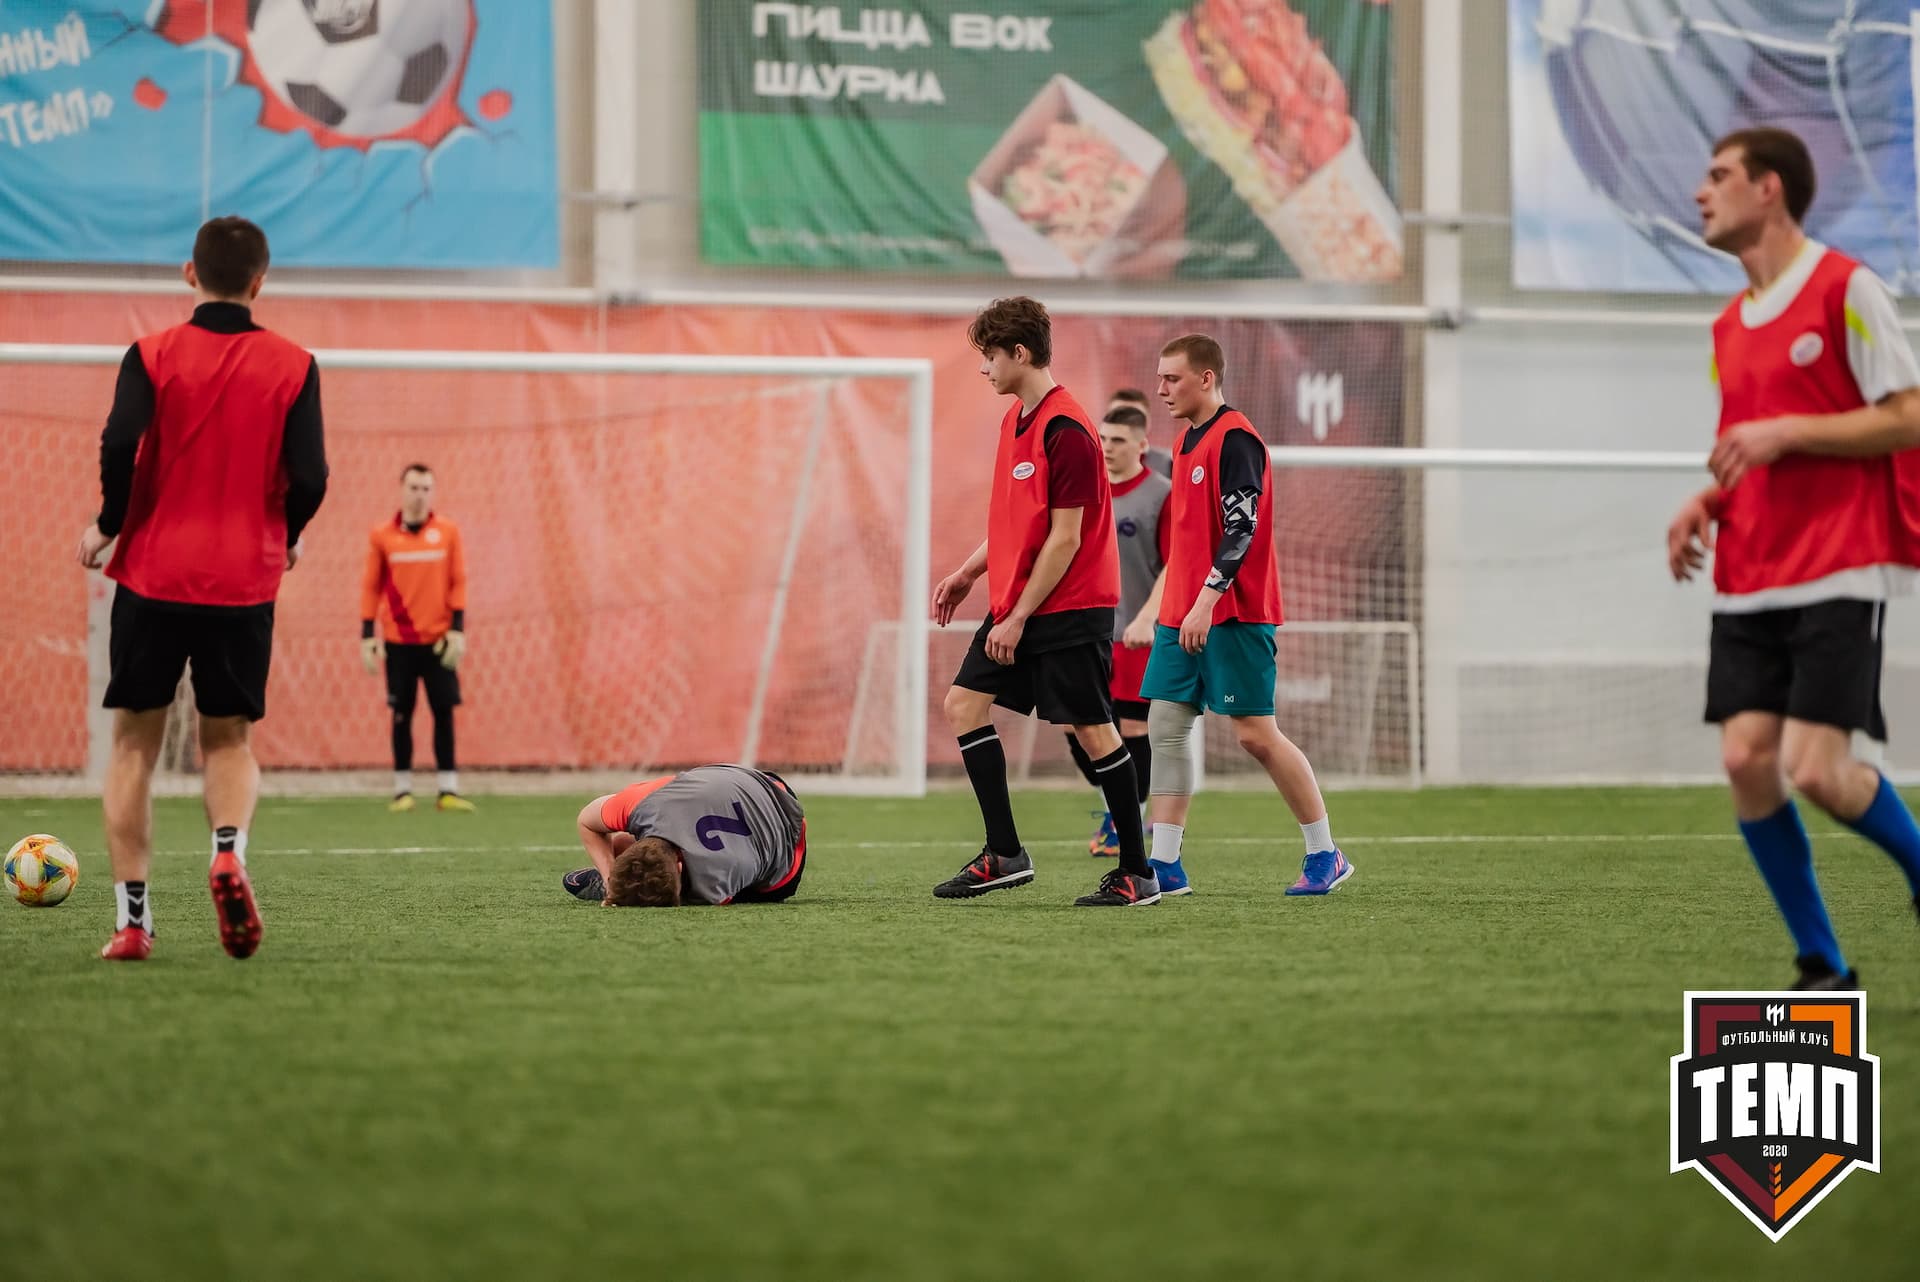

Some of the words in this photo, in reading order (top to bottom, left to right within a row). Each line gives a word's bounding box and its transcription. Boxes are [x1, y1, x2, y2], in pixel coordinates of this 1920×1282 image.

[753, 2, 931, 50] ПИЦЦА
[950, 13, 1053, 51] ВОК
[754, 60, 946, 102] ШАУРМА
[0, 88, 114, 147] ТЕМП»
[695, 801, 752, 851] 2
